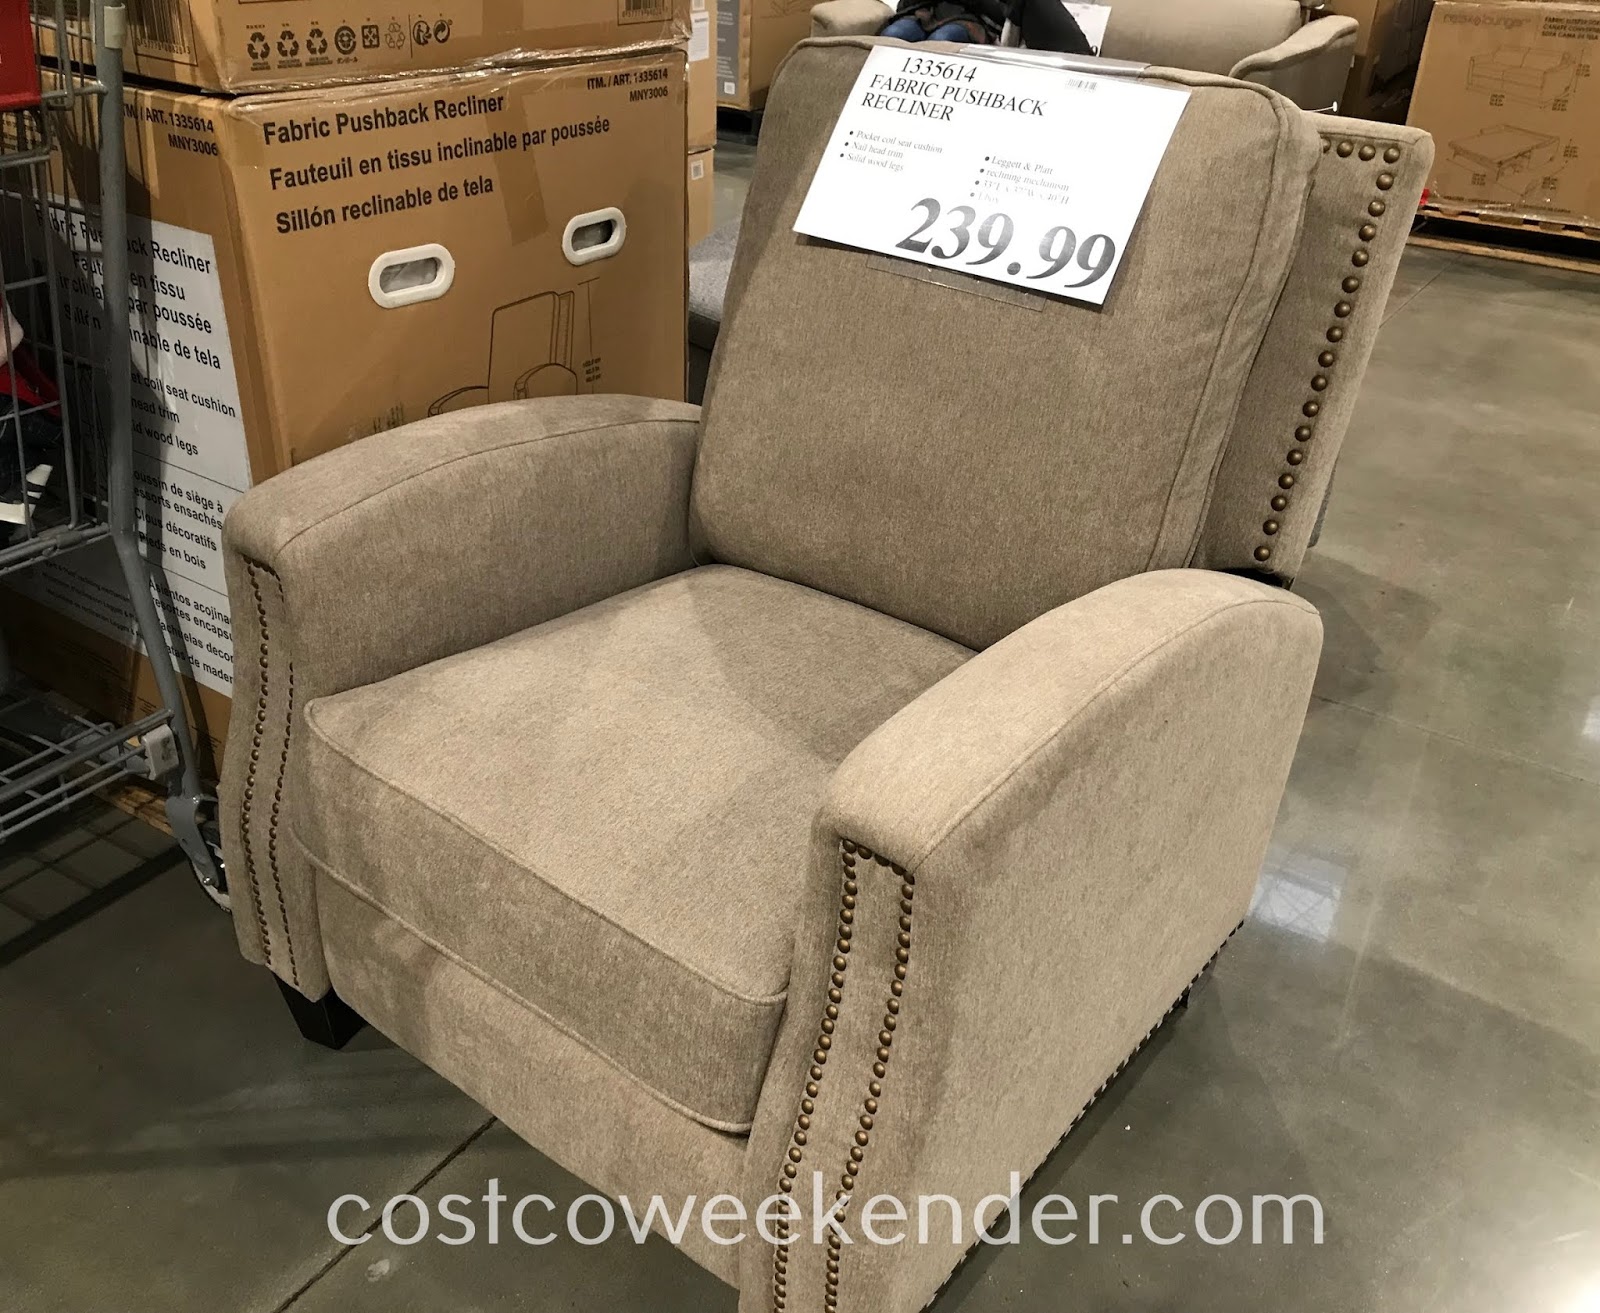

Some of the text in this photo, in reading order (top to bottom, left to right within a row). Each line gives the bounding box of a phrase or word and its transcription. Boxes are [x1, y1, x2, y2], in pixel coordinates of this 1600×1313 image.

[587, 76, 607, 90] ITM.
[613, 73, 632, 87] ART.
[633, 68, 668, 84] 1335614
[901, 56, 978, 82] 1335614
[629, 86, 669, 102] MNY3006
[861, 92, 954, 121] RECLINER
[869, 73, 1048, 116] FABRIC PUSHBACK
[145, 107, 168, 125] ART.
[169, 112, 215, 134] 1335614
[263, 95, 504, 145] Fabric Pushback Recliner
[168, 133, 219, 156] MNY3006
[269, 115, 610, 190] Fauteuil en tissu inclinable par poussée
[852, 141, 868, 151] Nail
[868, 144, 887, 155] head
[856, 130, 881, 142] Pocket
[898, 139, 912, 148] seat
[913, 143, 944, 154] cushion
[847, 152, 867, 164] Solid
[888, 161, 904, 172] legs
[276, 175, 494, 234] Sillón reclinable de tela
[151, 240, 211, 274] Recliner
[895, 197, 1116, 288] 239.99
[130, 272, 147, 289] en
[150, 275, 185, 301] tissu
[128, 297, 148, 315] par
[153, 304, 212, 334] poussée
[174, 339, 191, 359] de
[194, 345, 221, 370] tela
[144, 377, 164, 392] coil
[165, 384, 189, 402] seat
[191, 393, 236, 418] cushion
[158, 406, 180, 424] trim
[145, 426, 173, 446] wood
[175, 435, 199, 456] legs
[133, 470, 168, 492] oussin
[170, 483, 183, 497] de
[185, 490, 214, 510] siège
[133, 486, 223, 530] essorts ensachés
[134, 507, 217, 552] Clous décoratifs
[138, 531, 206, 570] Pieds en bois
[160, 621, 204, 649] achuelas
[188, 655, 200, 668] de
[203, 663, 233, 685] mader
